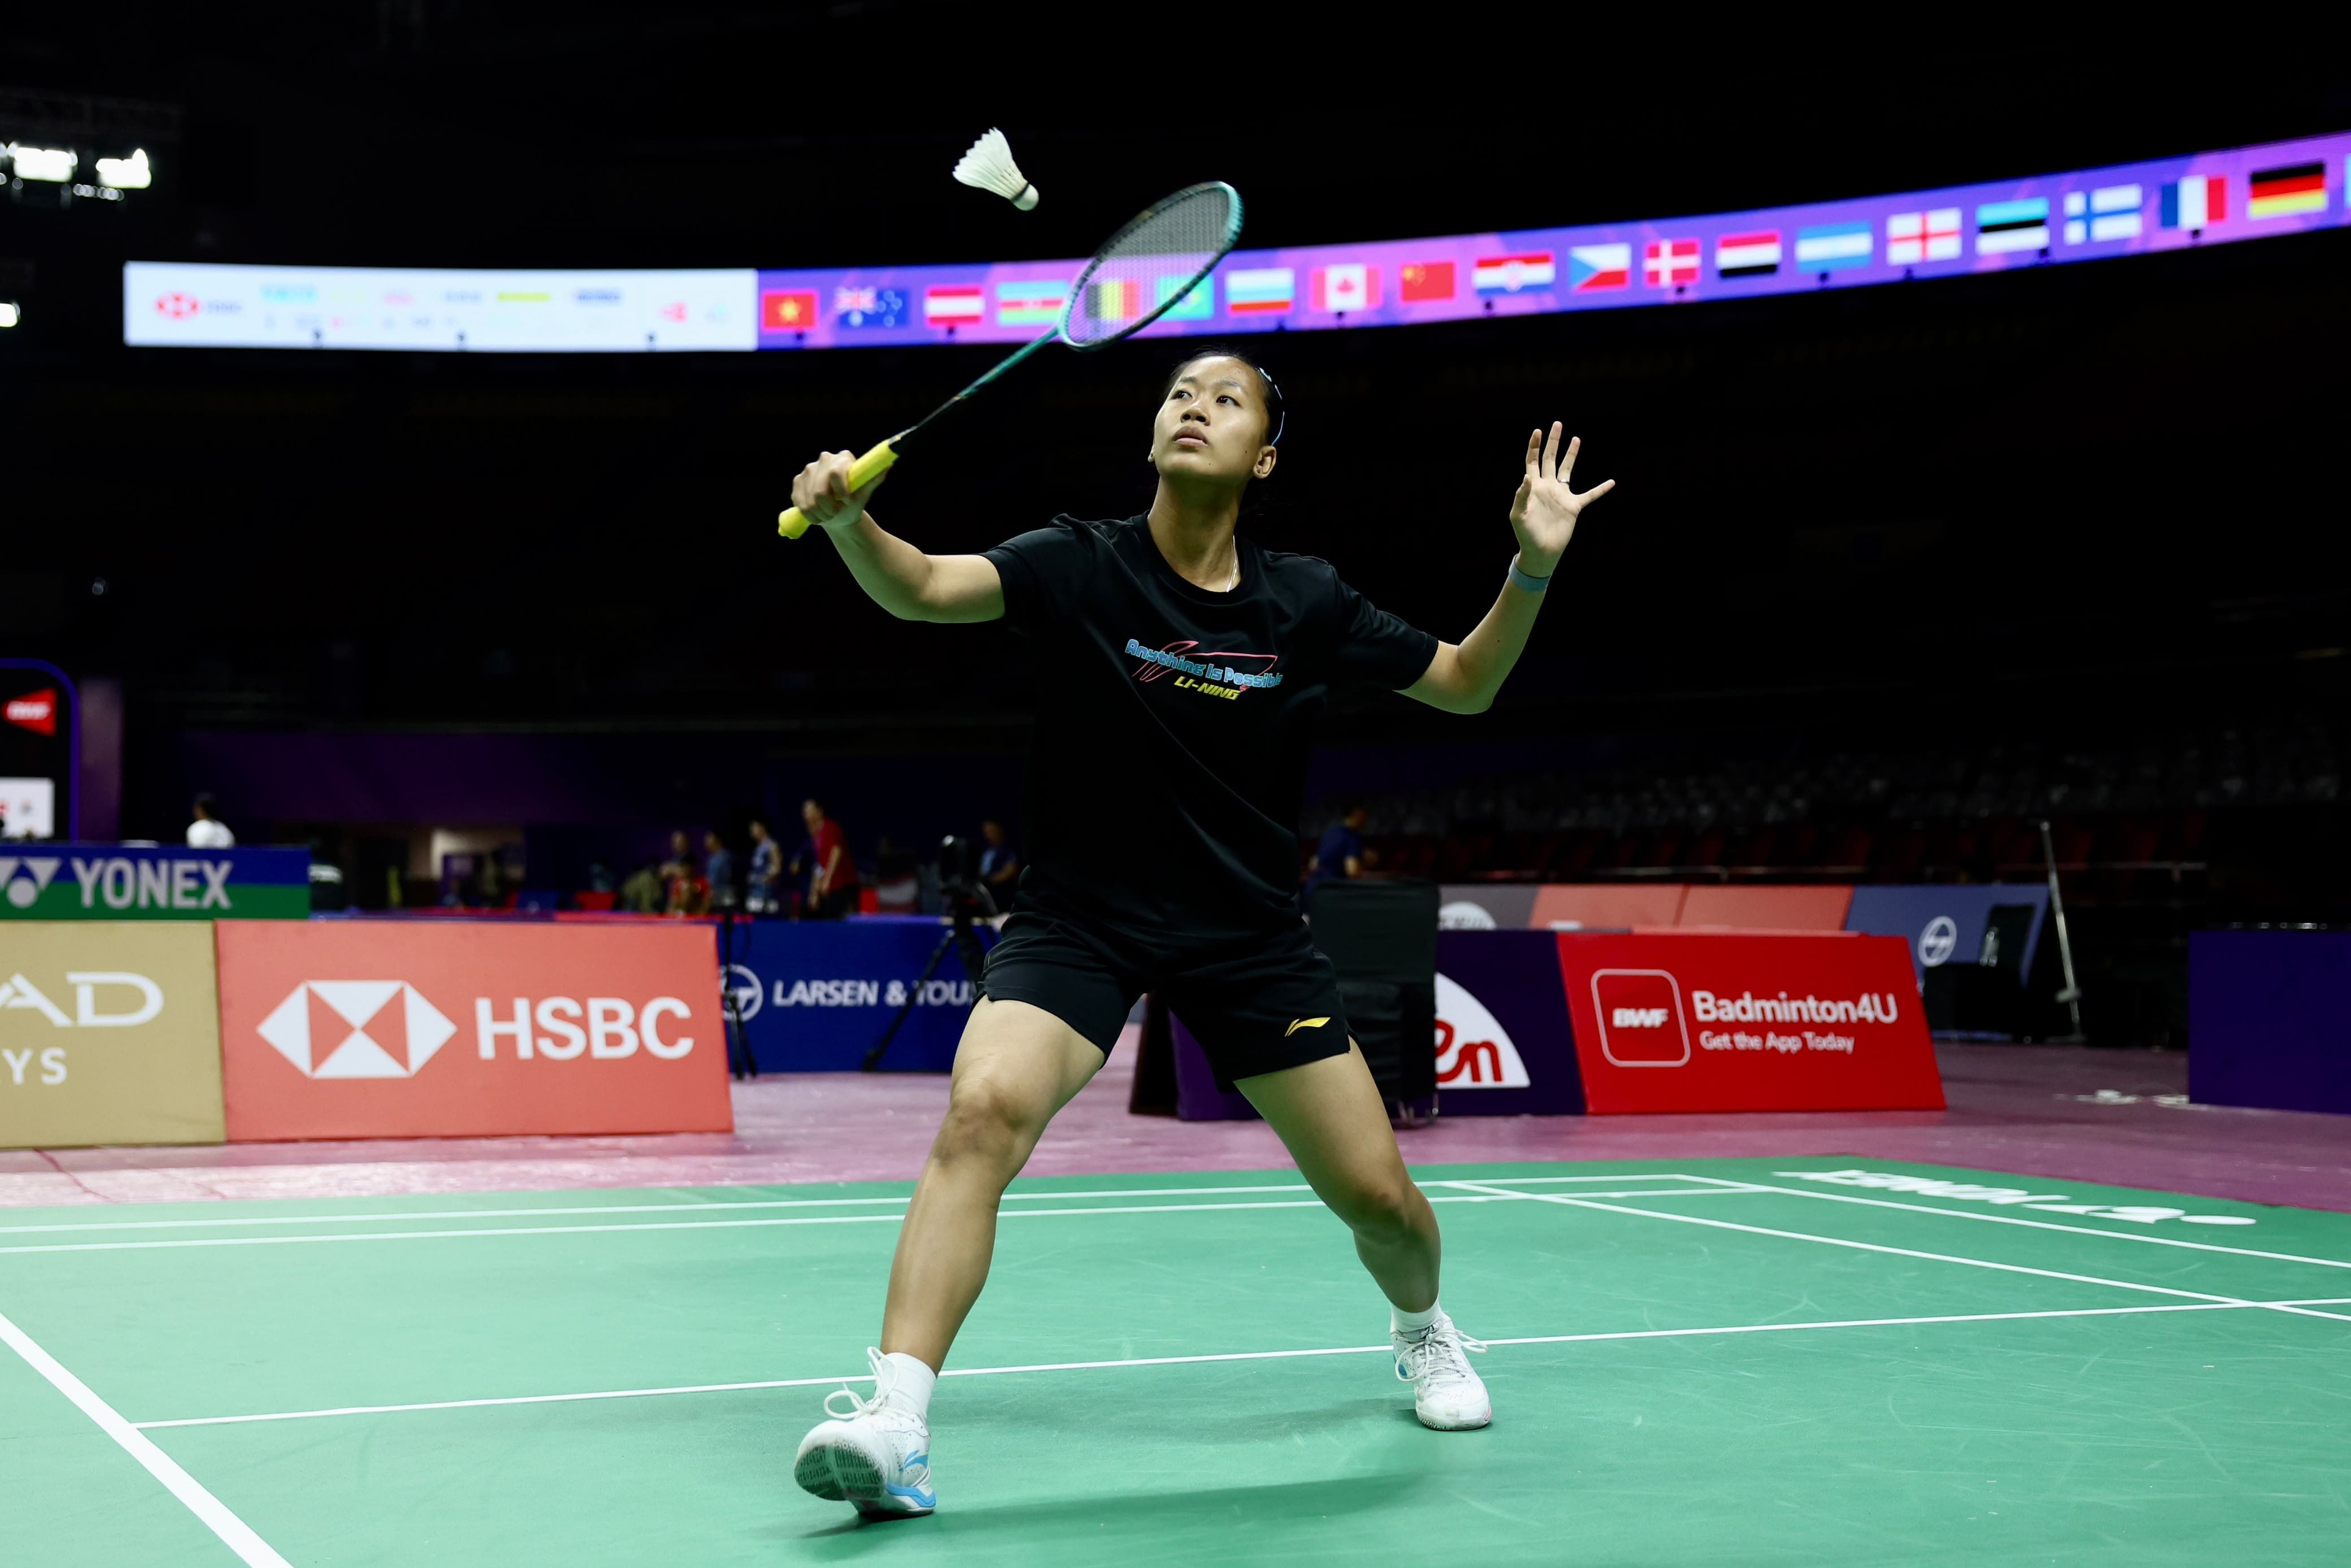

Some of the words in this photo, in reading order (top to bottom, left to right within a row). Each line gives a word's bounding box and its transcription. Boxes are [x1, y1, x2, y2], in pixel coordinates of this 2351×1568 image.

[1125, 639, 1206, 676] Anything
[1205, 664, 1223, 681] Is
[1224, 667, 1283, 688] Possible
[1174, 676, 1242, 700] LI-NING
[72, 858, 233, 909] YONEX
[773, 980, 879, 1006] LARSEN
[884, 980, 907, 1006] &
[912, 980, 975, 1006] TOU
[1692, 991, 1898, 1024] Badminton4U
[475, 996, 694, 1060] HSBC
[1613, 1008, 1668, 1028] BWF
[1699, 1030, 1733, 1050] Get
[1733, 1031, 1763, 1050] the
[1765, 1031, 1802, 1054] App
[1802, 1031, 1854, 1055] Today
